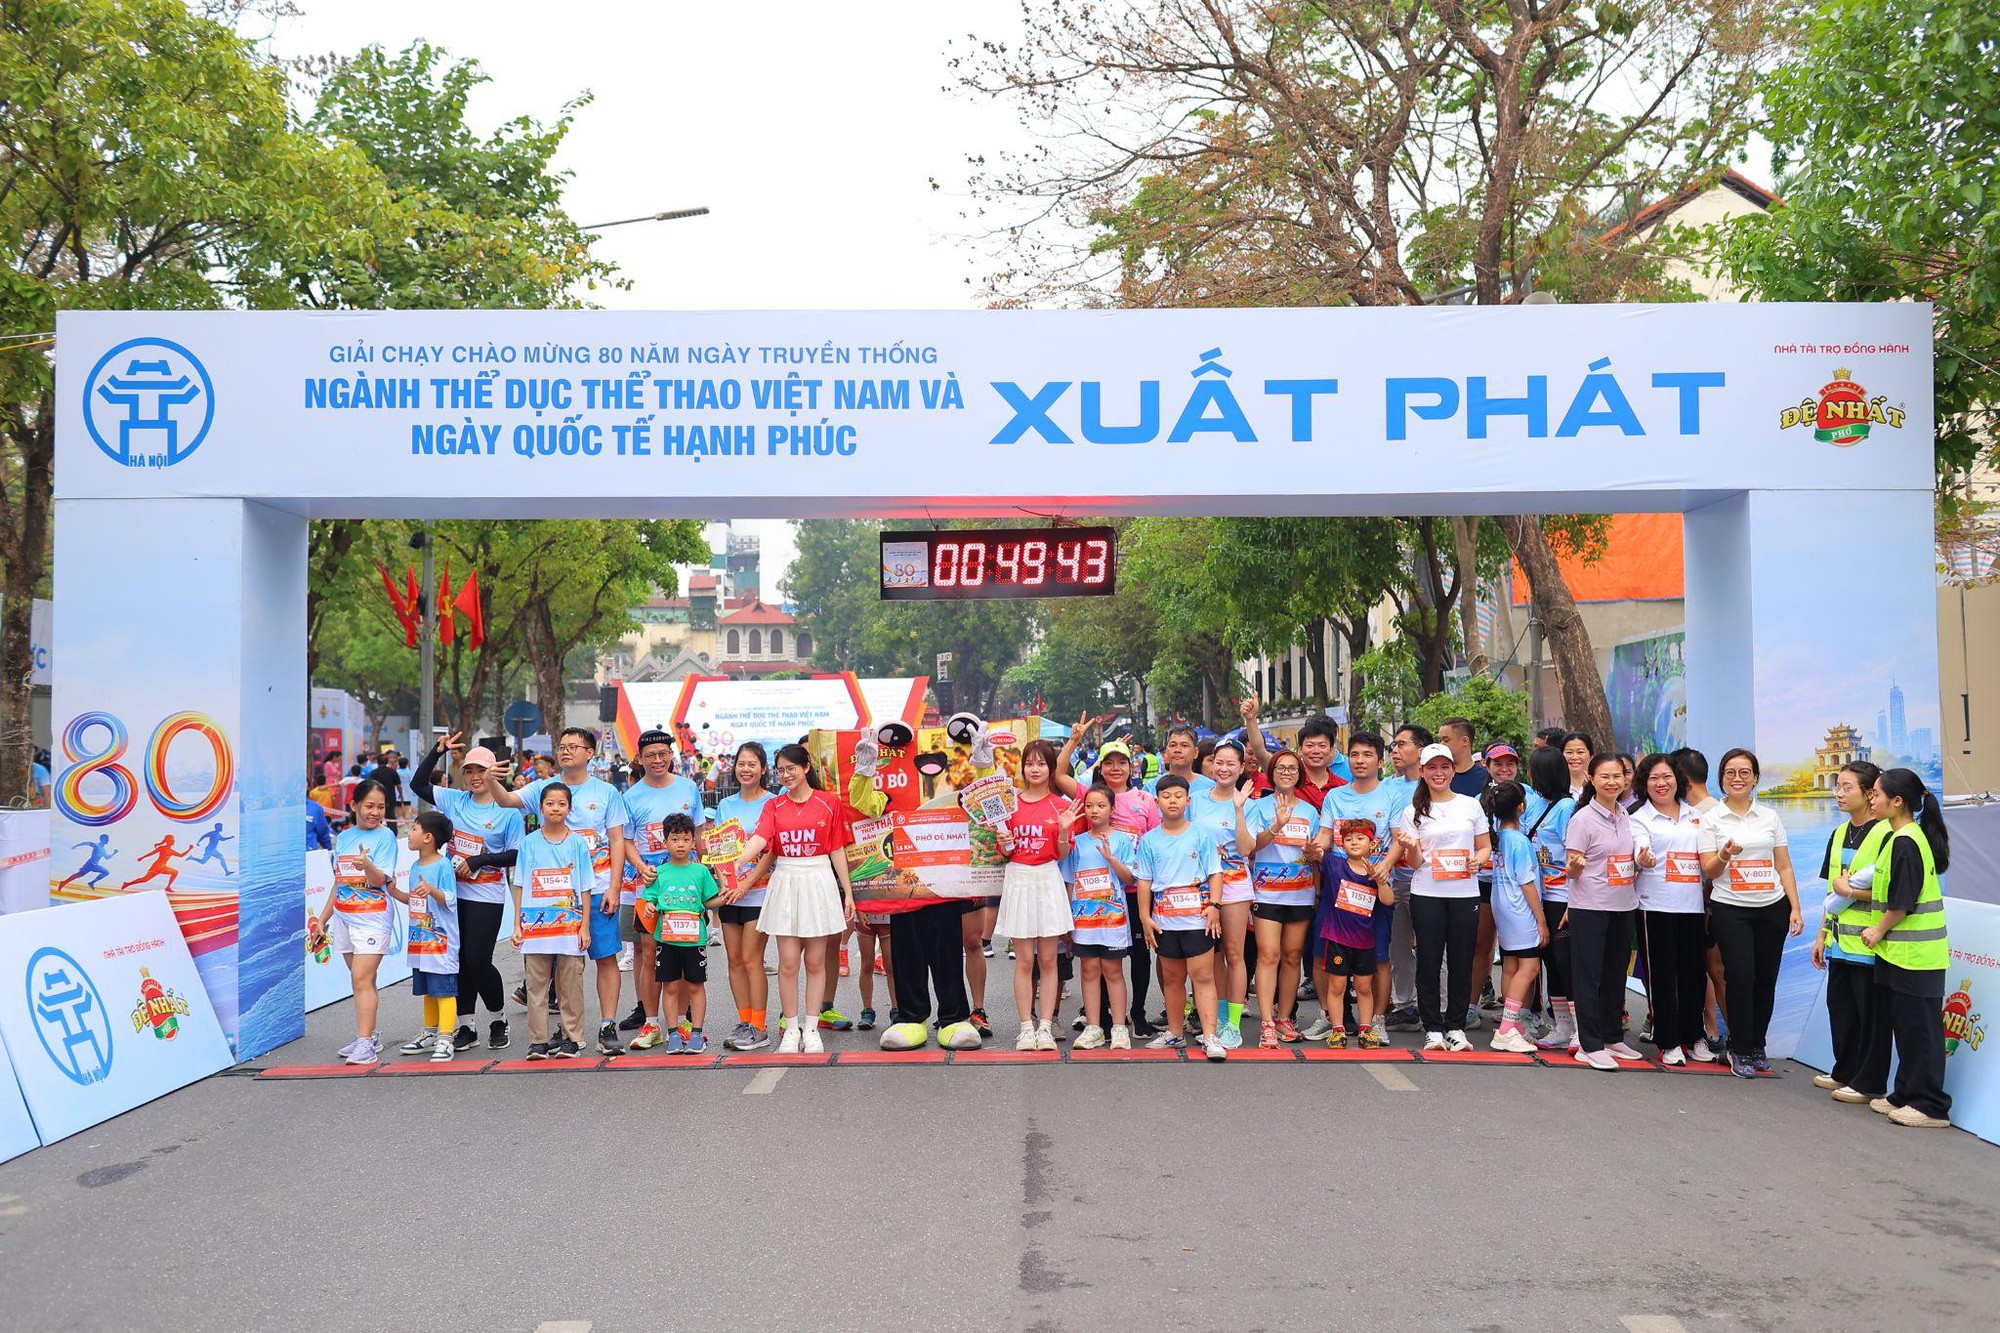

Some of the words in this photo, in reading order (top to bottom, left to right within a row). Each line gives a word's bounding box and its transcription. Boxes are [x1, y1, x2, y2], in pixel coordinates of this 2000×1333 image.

[329, 339, 374, 364] GIẢI
[382, 345, 444, 367] CHẠY
[452, 342, 517, 364] CHÀO
[524, 343, 591, 364] MỪNG
[598, 347, 623, 364] 80
[631, 341, 680, 364] NĂM
[688, 342, 750, 364] NGÀY
[759, 339, 851, 364] TRUYỀN
[858, 340, 938, 364] THỐNG
[1774, 343, 1797, 354] NHÀ
[1800, 343, 1817, 354] TÀI
[1820, 344, 1841, 356] TRỢ
[1844, 341, 1876, 354] ĐỒNG
[1879, 343, 1909, 354] HÀNH
[304, 371, 420, 410] NGÀNH
[430, 370, 500, 410] THỂ
[505, 379, 572, 417] DỤC
[581, 370, 652, 410] THỂ
[653, 379, 742, 410] THAO
[751, 371, 823, 417] VIỆT
[834, 379, 910, 410] NAM
[919, 371, 965, 410] VÀ
[990, 347, 1338, 445] XUẤT
[1385, 356, 1727, 442] PHÁT
[1780, 397, 1818, 430] ĐỆ
[1825, 396, 1906, 429] NHẤT
[411, 416, 502, 455] NGÀY
[513, 414, 603, 459] QUỐC
[611, 414, 655, 456] TẾ
[664, 425, 756, 463] HẠNH
[768, 417, 858, 456] PHÚC
[129, 453, 146, 467] HÀ
[148, 453, 168, 469] NỘI
[54, 711, 235, 827] 80
[779, 829, 816, 844] RUN
[1286, 825, 1308, 833] 1151-2
[542, 876, 569, 884] 1154-2
[1083, 876, 1108, 885] 1108-2
[1172, 895, 1199, 903] 1134-3
[673, 921, 697, 929] 1137-3
[131, 999, 150, 1033] ĐỆ
[148, 988, 190, 1016] NHẤT
[1943, 1011, 1985, 1051] NHẤT
